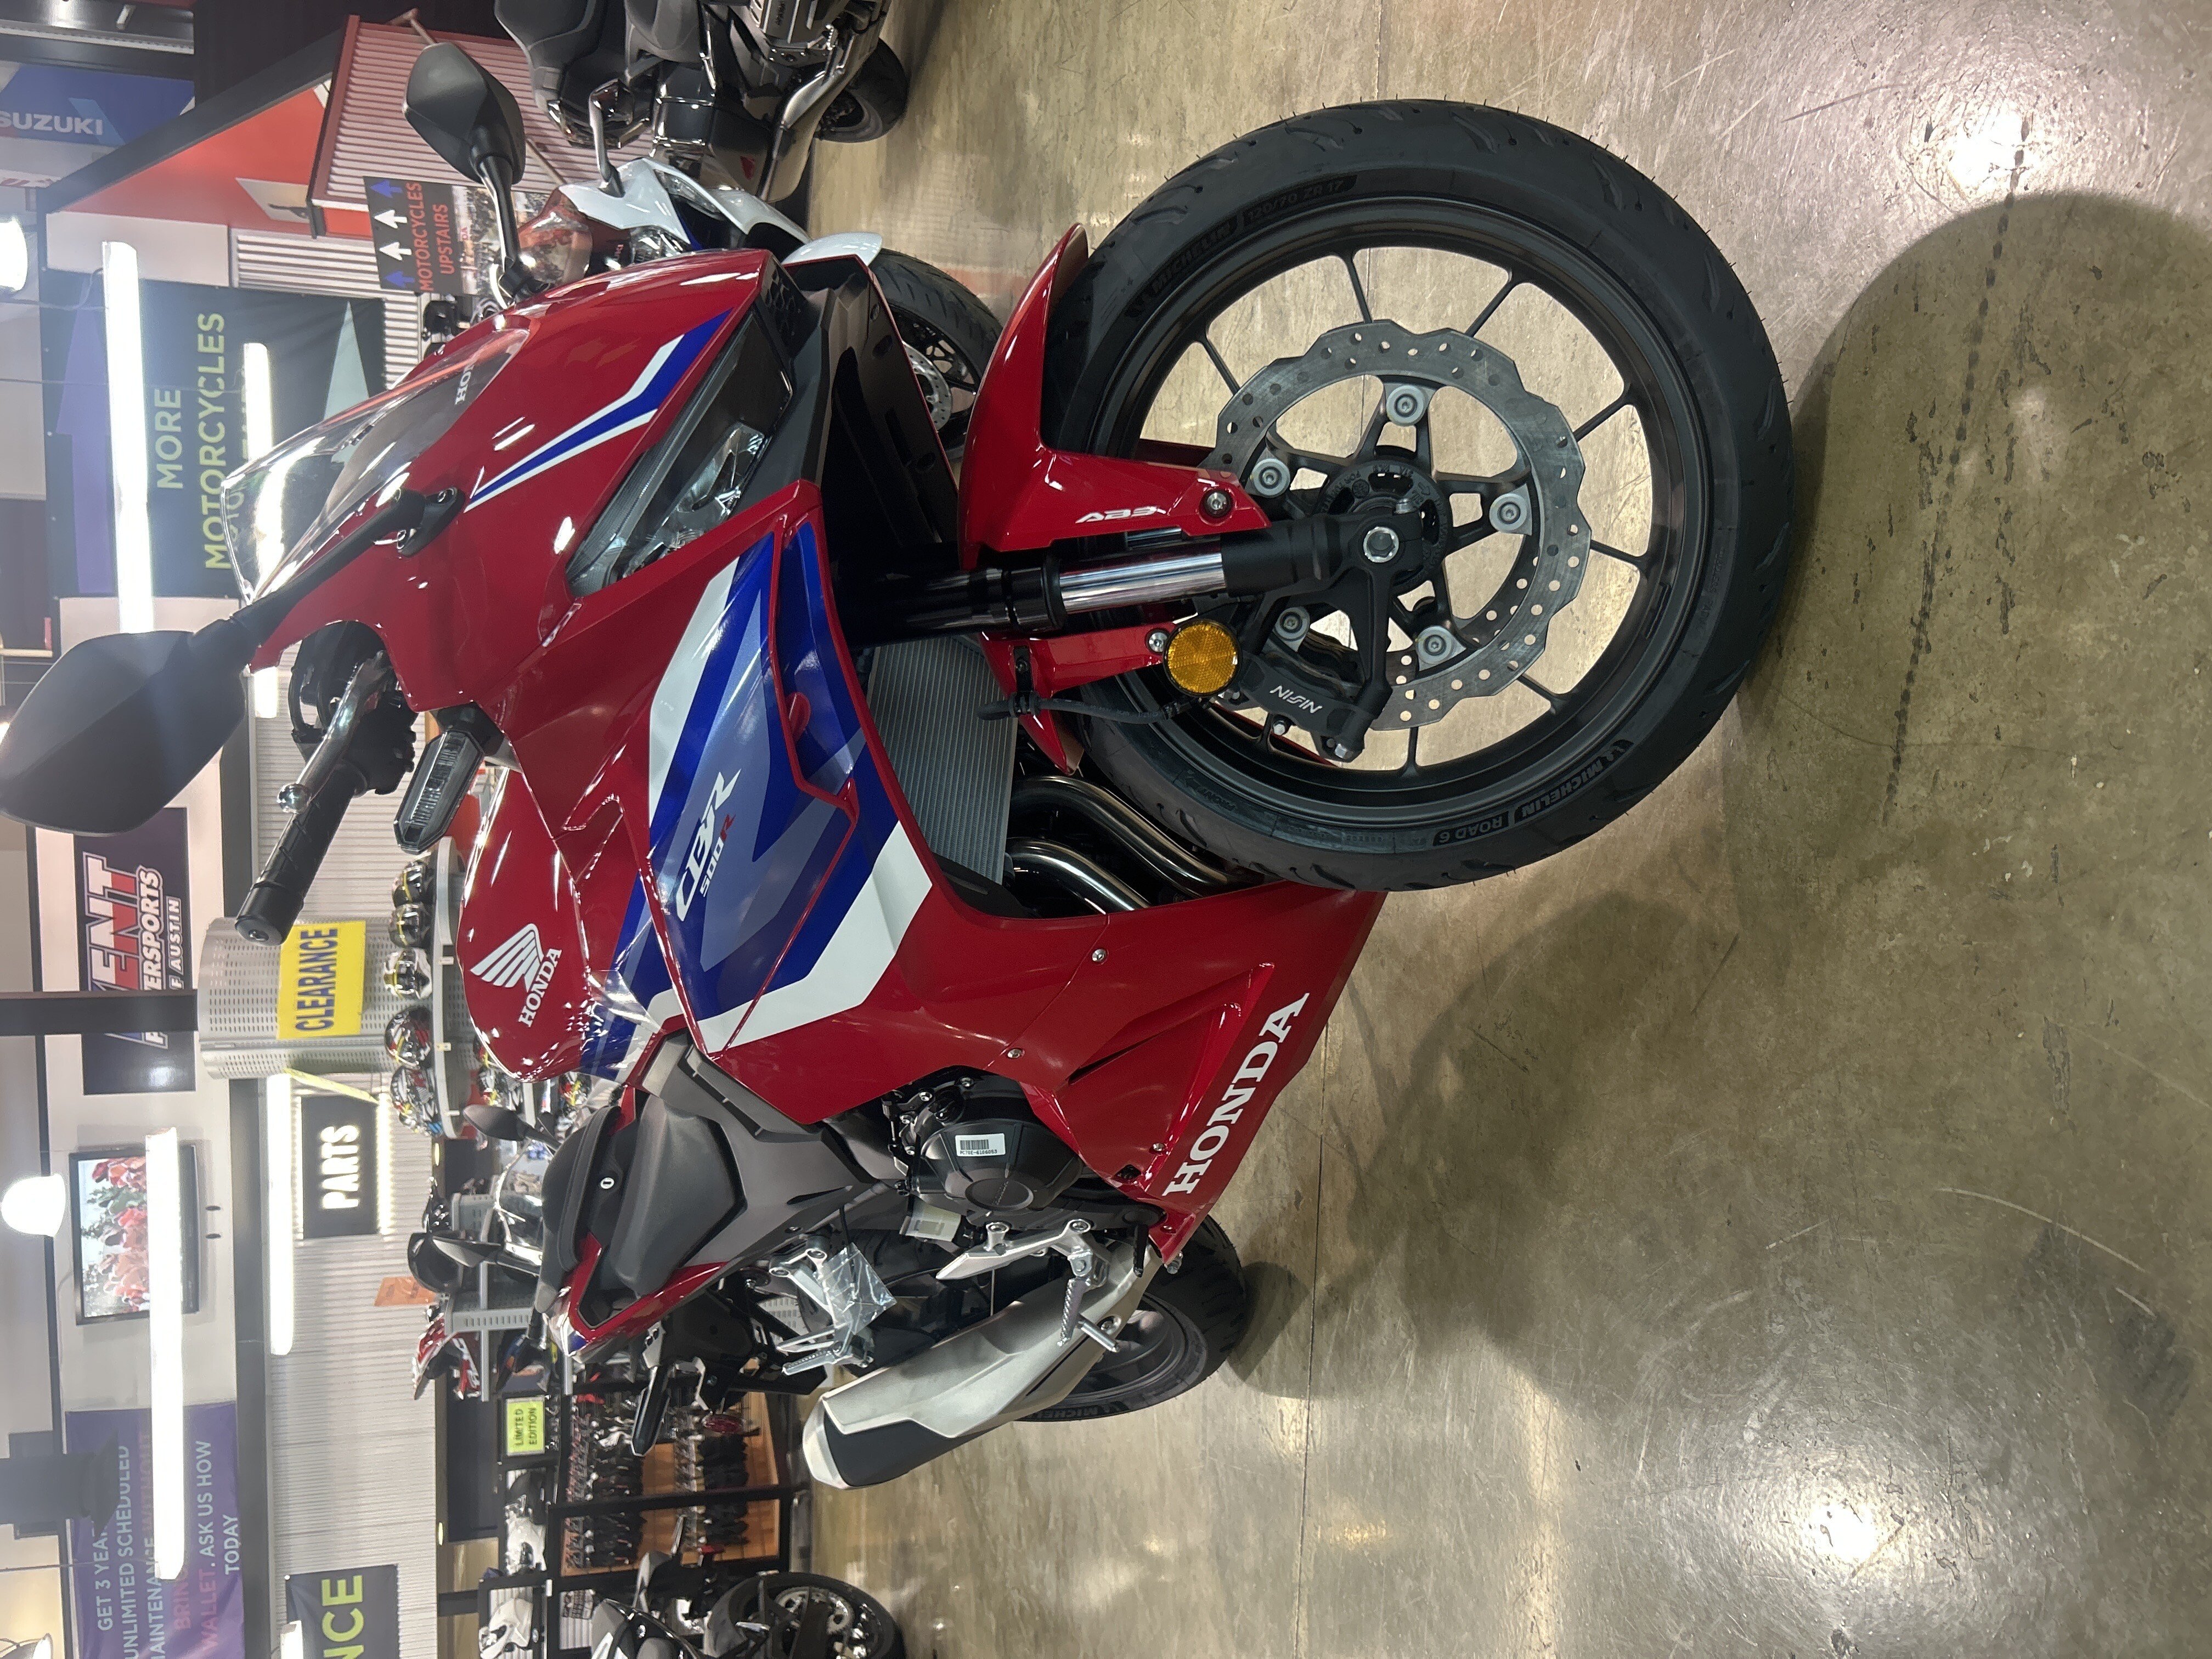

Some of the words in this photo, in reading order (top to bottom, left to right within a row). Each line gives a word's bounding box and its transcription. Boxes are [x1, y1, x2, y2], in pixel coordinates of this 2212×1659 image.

[405, 181, 435, 292] MOTORCYCLES
[432, 204, 455, 275] UPSTAIRS
[154, 388, 184, 489] MORE
[197, 312, 233, 570] MOTORCYCLES
[1074, 505, 1167, 524] ABS
[1521, 758, 1606, 817] MICHELIN
[675, 768, 742, 922] CBR
[699, 813, 736, 898] 500R
[1437, 831, 1451, 843] 6
[1457, 815, 1504, 838] ROAD
[139, 866, 165, 1045] PERSPORTS
[167, 898, 182, 971] AUSTIN
[168, 976, 183, 989] F
[294, 928, 338, 1031] CLEARANCE
[517, 947, 563, 1028] HONDA
[1161, 992, 1310, 1197] HONDA
[319, 1125, 359, 1210] PARTS
[513, 1408, 524, 1446] LIMITED
[527, 1407, 538, 1445] EDITION
[195, 1440, 212, 1486] HOW
[115, 1445, 134, 1557] SCHEDULED
[196, 1492, 213, 1516] US
[198, 1521, 216, 1557] ASK
[223, 1514, 240, 1575] TODAY
[94, 1579, 111, 1589] 3
[95, 1595, 114, 1630] GET
[119, 1562, 139, 1659] UNLIMITED
